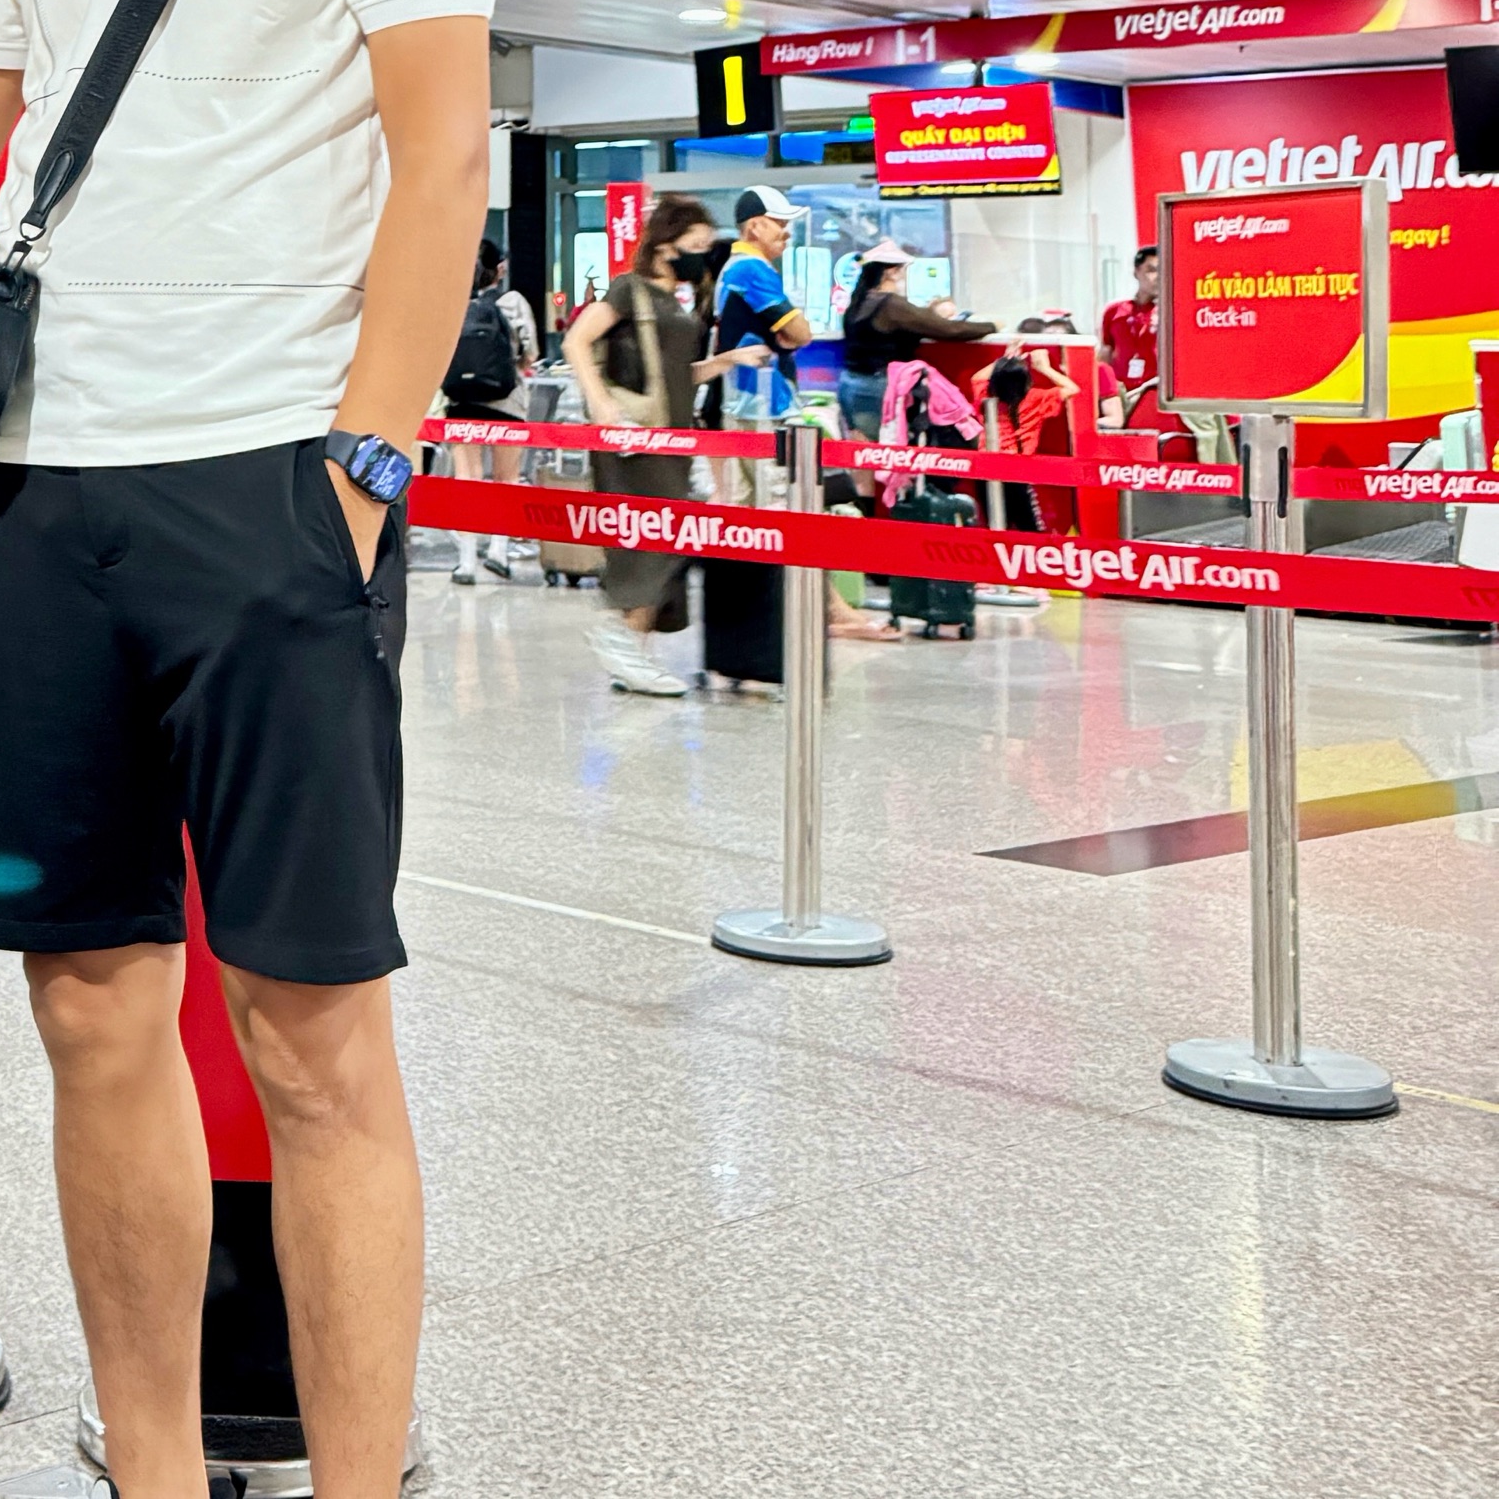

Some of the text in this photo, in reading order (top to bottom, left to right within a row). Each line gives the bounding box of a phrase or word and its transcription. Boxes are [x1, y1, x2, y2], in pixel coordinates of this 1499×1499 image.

[1196, 266, 1359, 302] LỐI VÀO LÀM THỦ TỤC
[1196, 306, 1257, 328] Check-in
